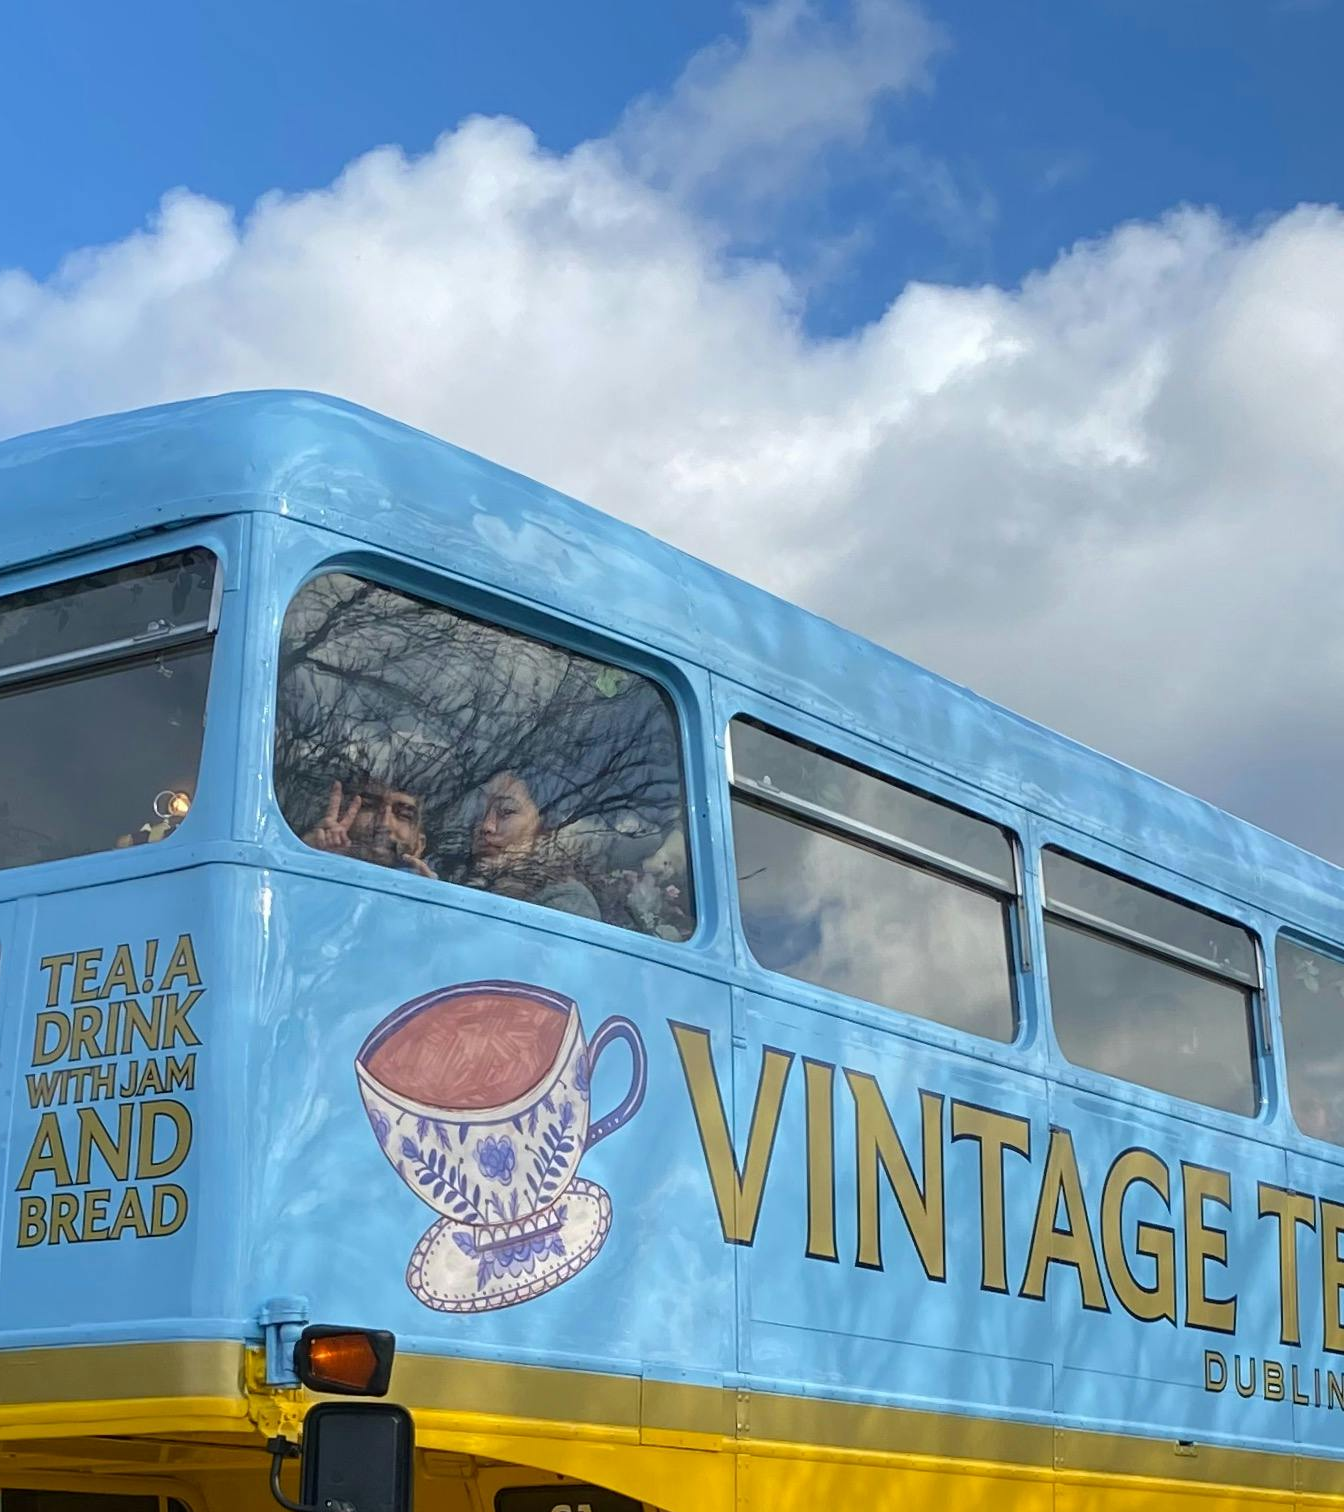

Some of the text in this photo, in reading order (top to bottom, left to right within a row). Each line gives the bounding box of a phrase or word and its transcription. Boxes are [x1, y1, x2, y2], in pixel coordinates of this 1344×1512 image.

[32, 989, 205, 1067] DRINK
[26, 1053, 197, 1109] WITH JAM
[16, 1099, 194, 1191] AND
[666, 1018, 1238, 1335] VINTAGE
[17, 1184, 189, 1248] BREAD
